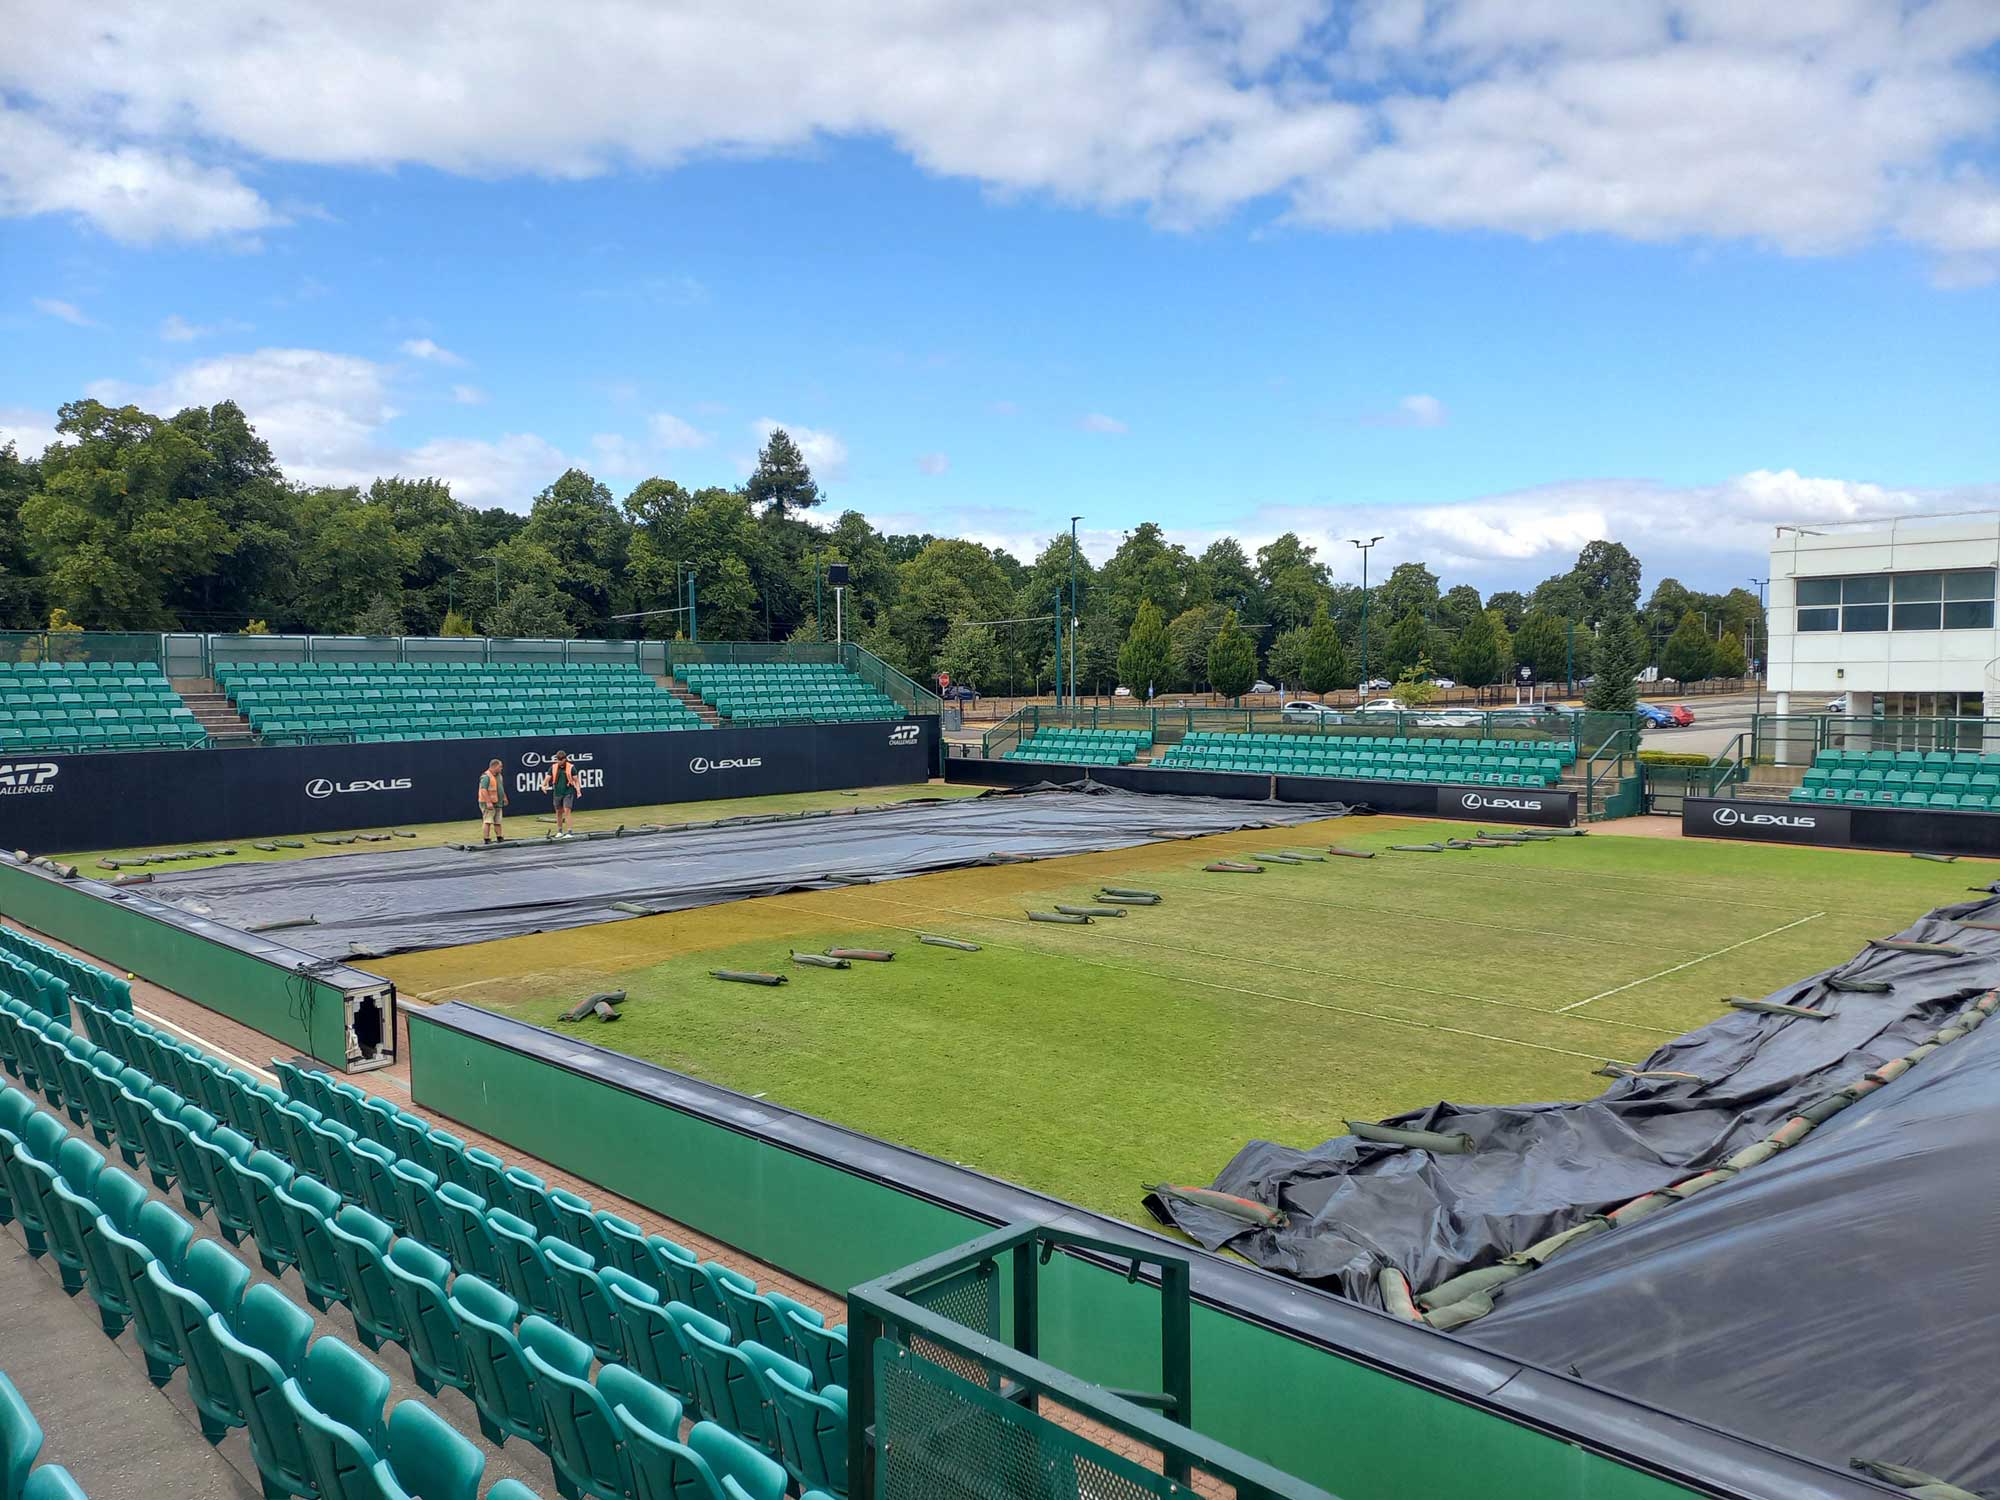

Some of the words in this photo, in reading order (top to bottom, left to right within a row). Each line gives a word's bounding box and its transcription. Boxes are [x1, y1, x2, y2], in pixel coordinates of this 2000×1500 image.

[888, 725, 920, 739] ATP
[710, 757, 762, 769] LEXUS
[0, 762, 59, 785] ATP
[516, 768, 604, 793] CHAGER
[0, 784, 54, 795] ALLENGER
[335, 778, 412, 793] LEXUS
[1483, 797, 1542, 810] LEXUS
[1740, 813, 1816, 828] LEXUS
